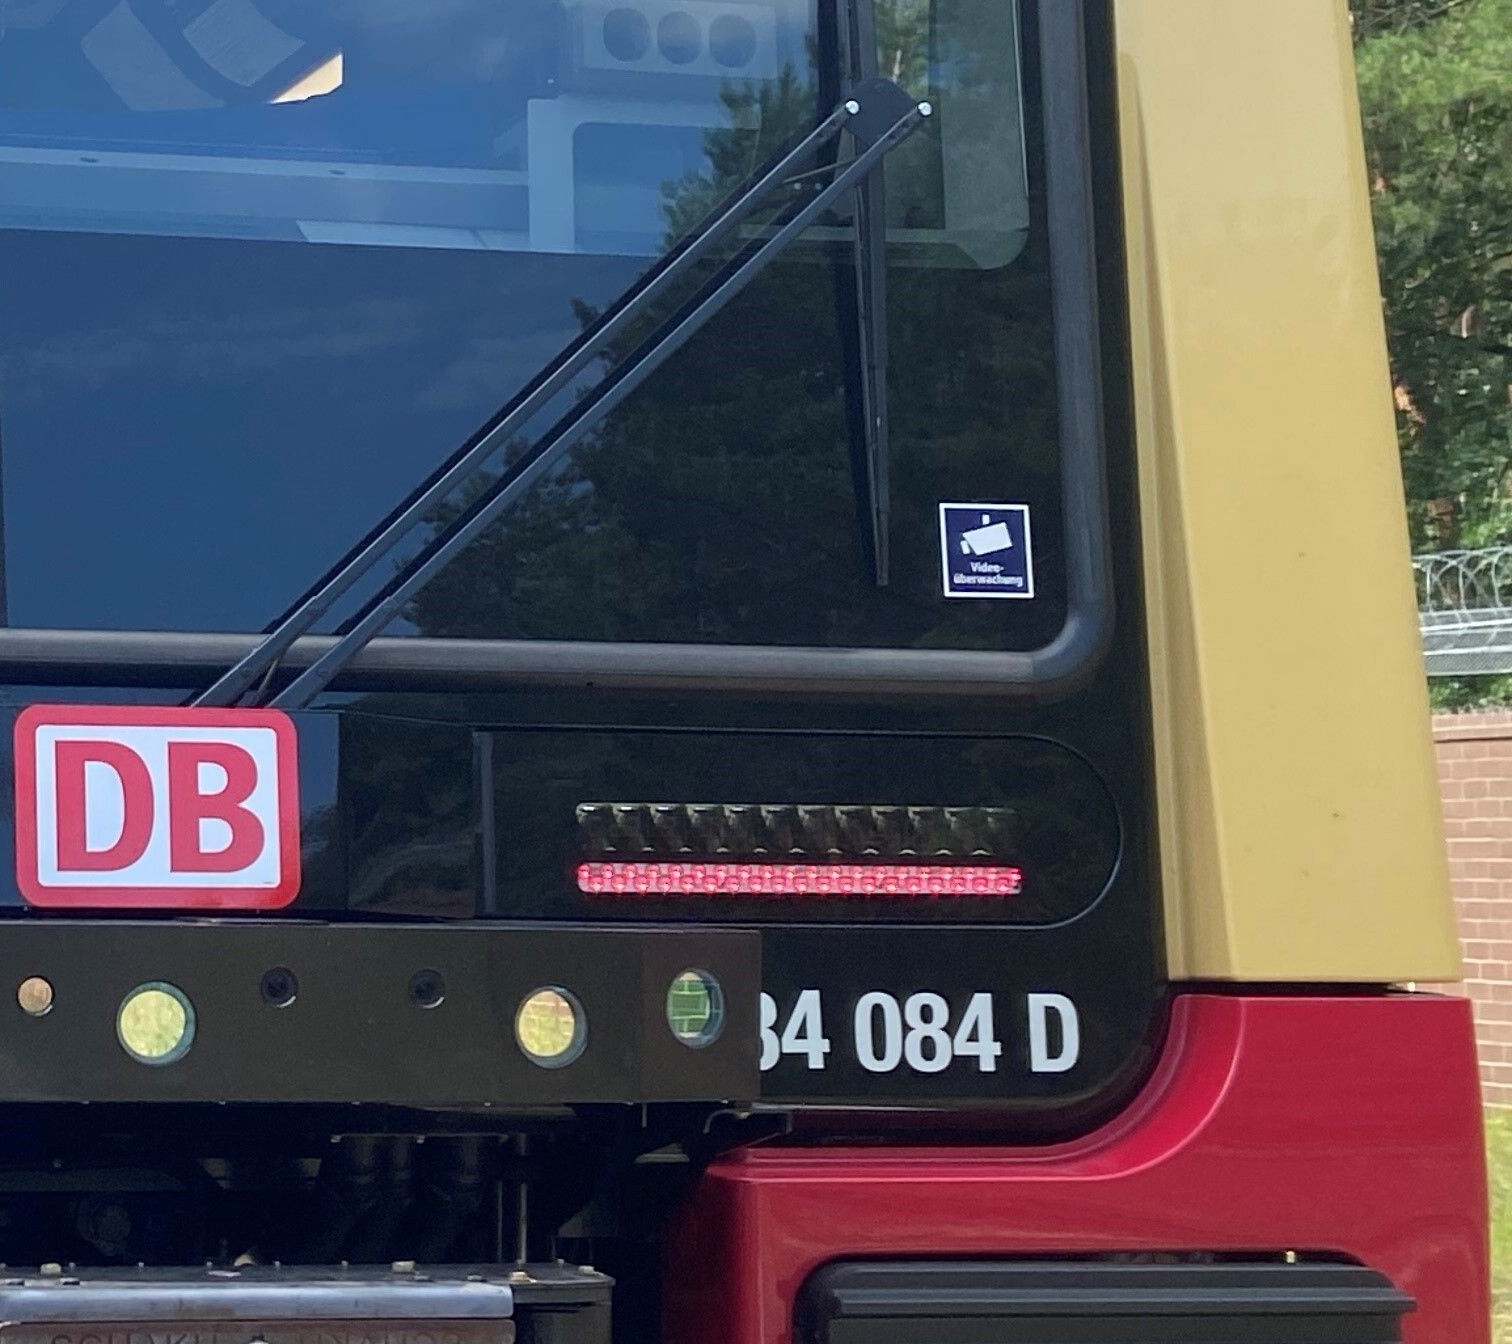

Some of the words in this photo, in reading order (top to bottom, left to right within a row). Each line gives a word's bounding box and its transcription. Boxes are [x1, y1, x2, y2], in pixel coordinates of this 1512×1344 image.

[970, 561, 1005, 573] Video-
[54, 739, 266, 874] DB
[854, 990, 1002, 1073] 084
[1027, 992, 1080, 1073] D
